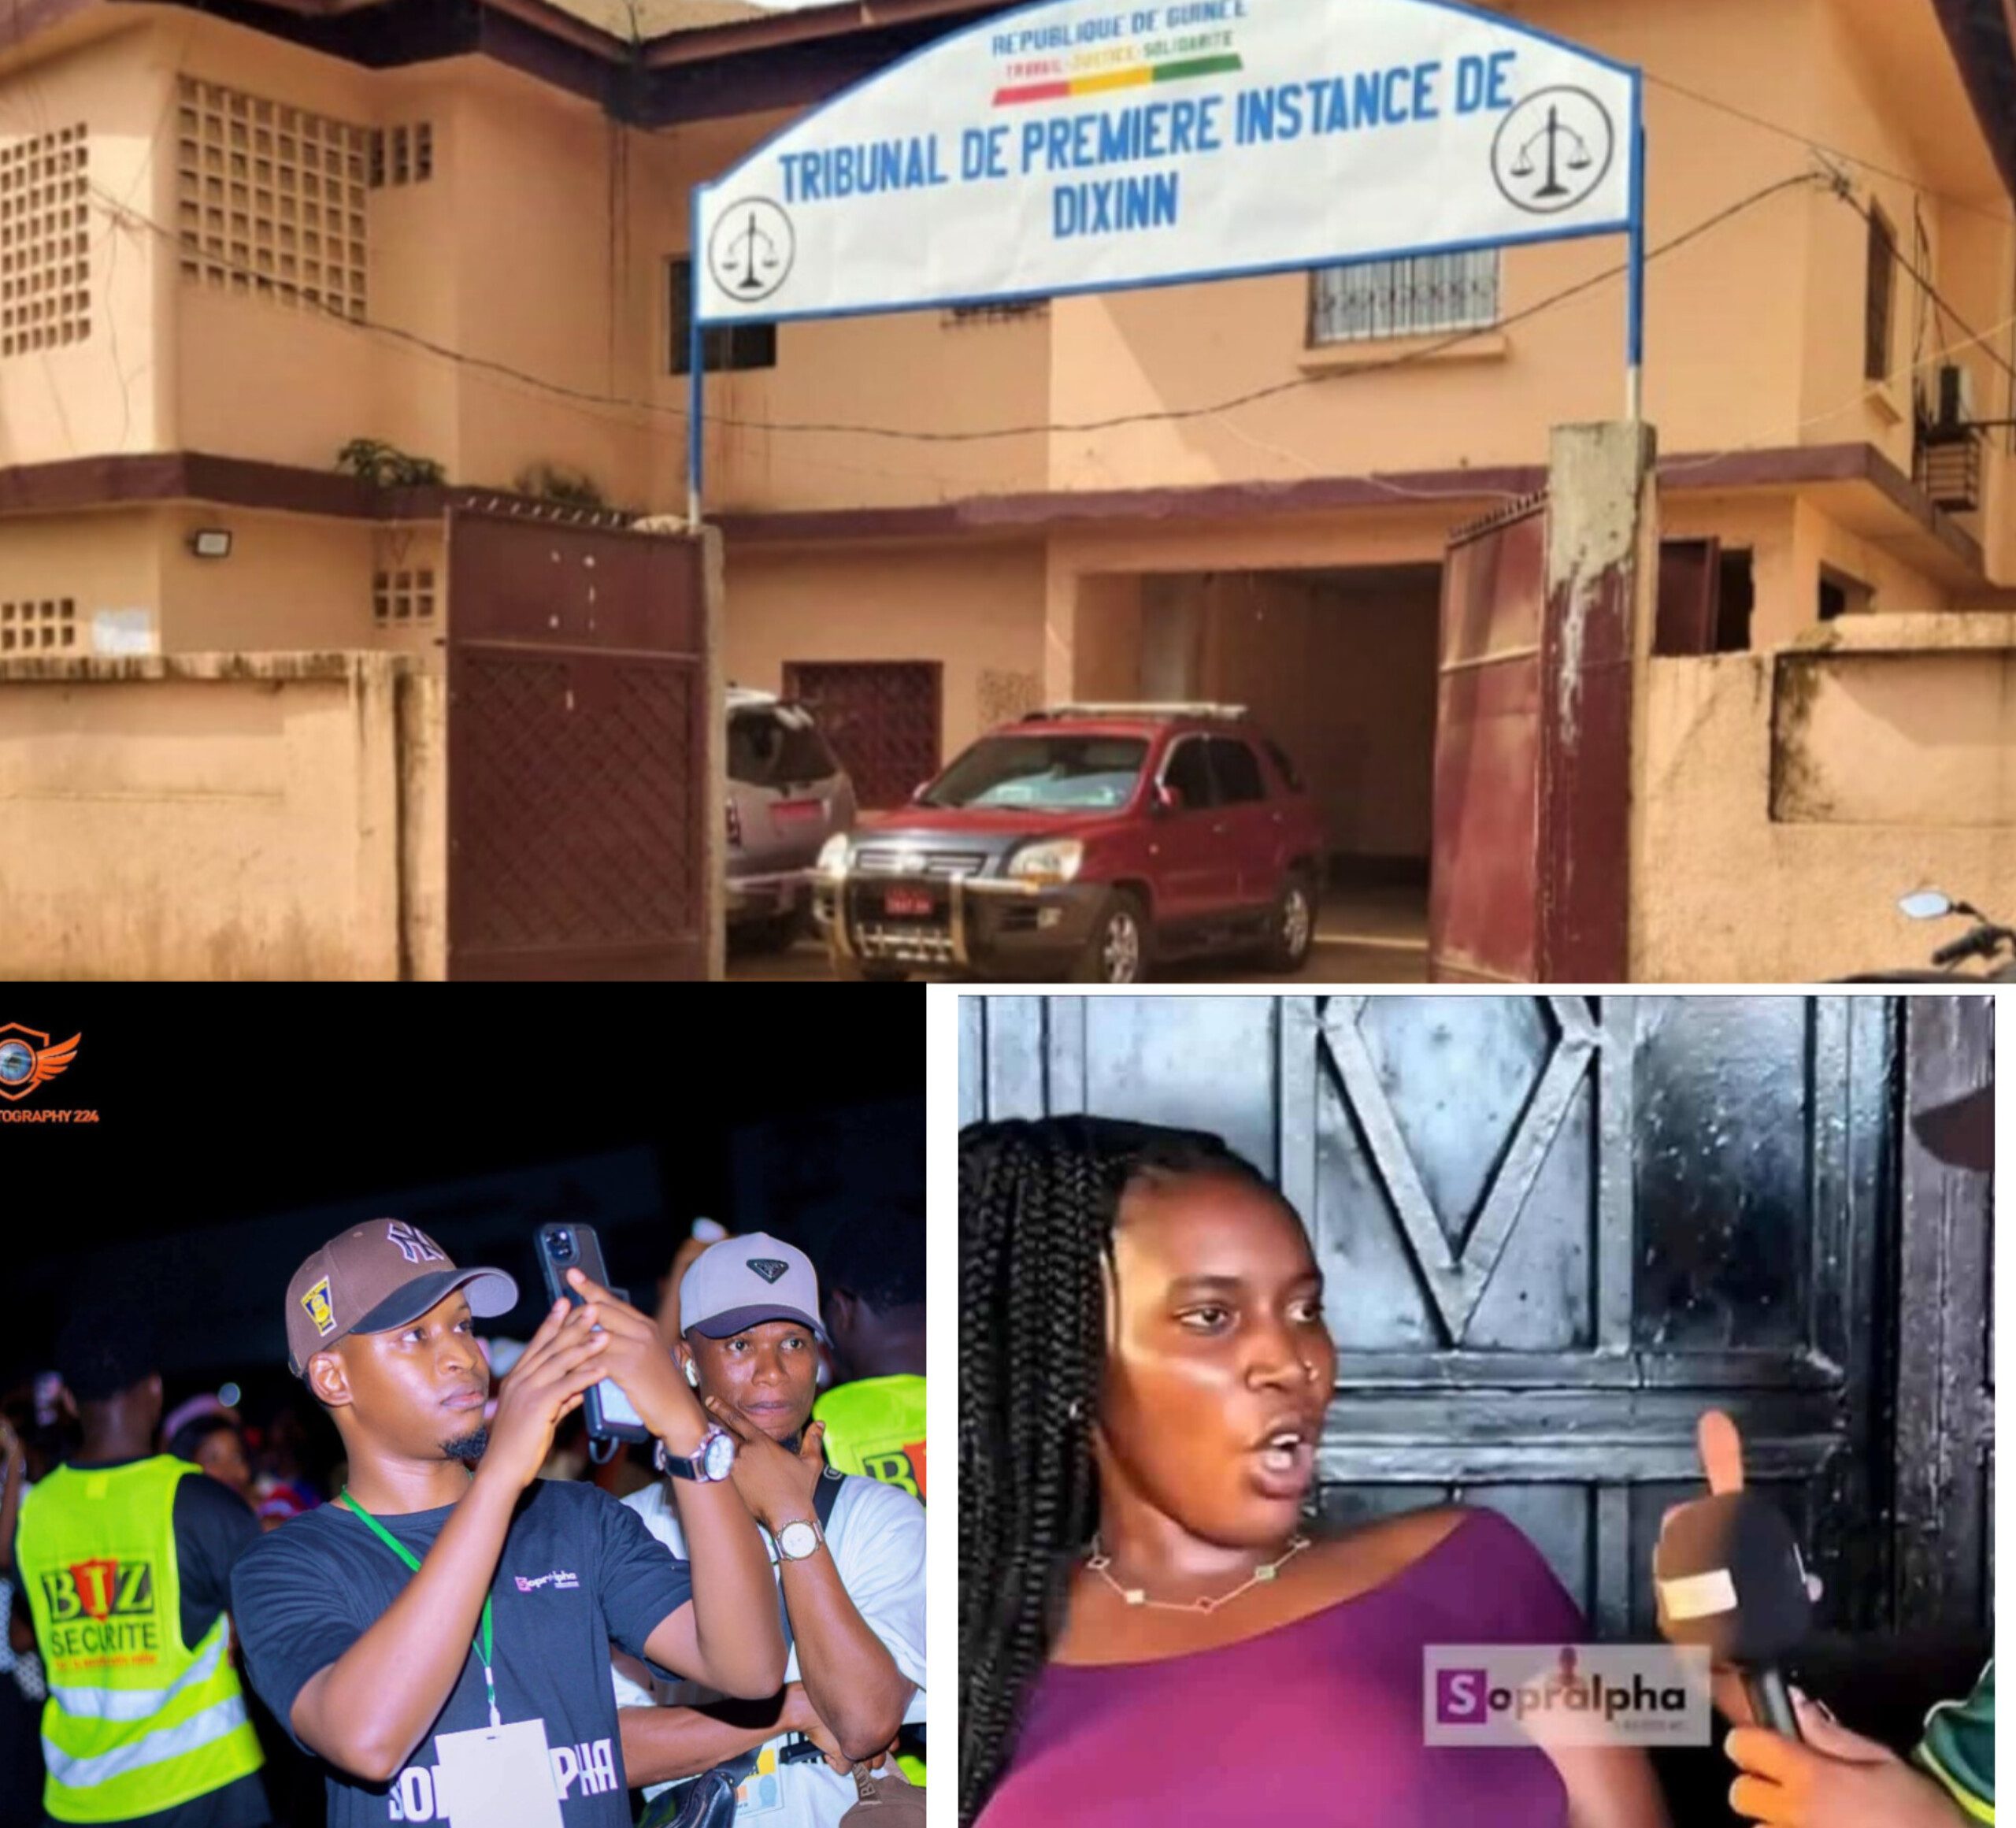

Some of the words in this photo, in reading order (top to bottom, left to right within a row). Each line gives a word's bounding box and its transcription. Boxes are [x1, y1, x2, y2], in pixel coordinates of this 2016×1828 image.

[992, 17, 1125, 57] REPUBLIQUE
[1131, 9, 1159, 34] DE
[778, 134, 948, 204] TRIBUNAL
[961, 124, 1010, 181] DE
[1022, 95, 1223, 174] PREMIERE
[1235, 61, 1442, 146] INSTANCE
[1455, 50, 1518, 114] DE
[1052, 171, 1179, 239] DIXINN
